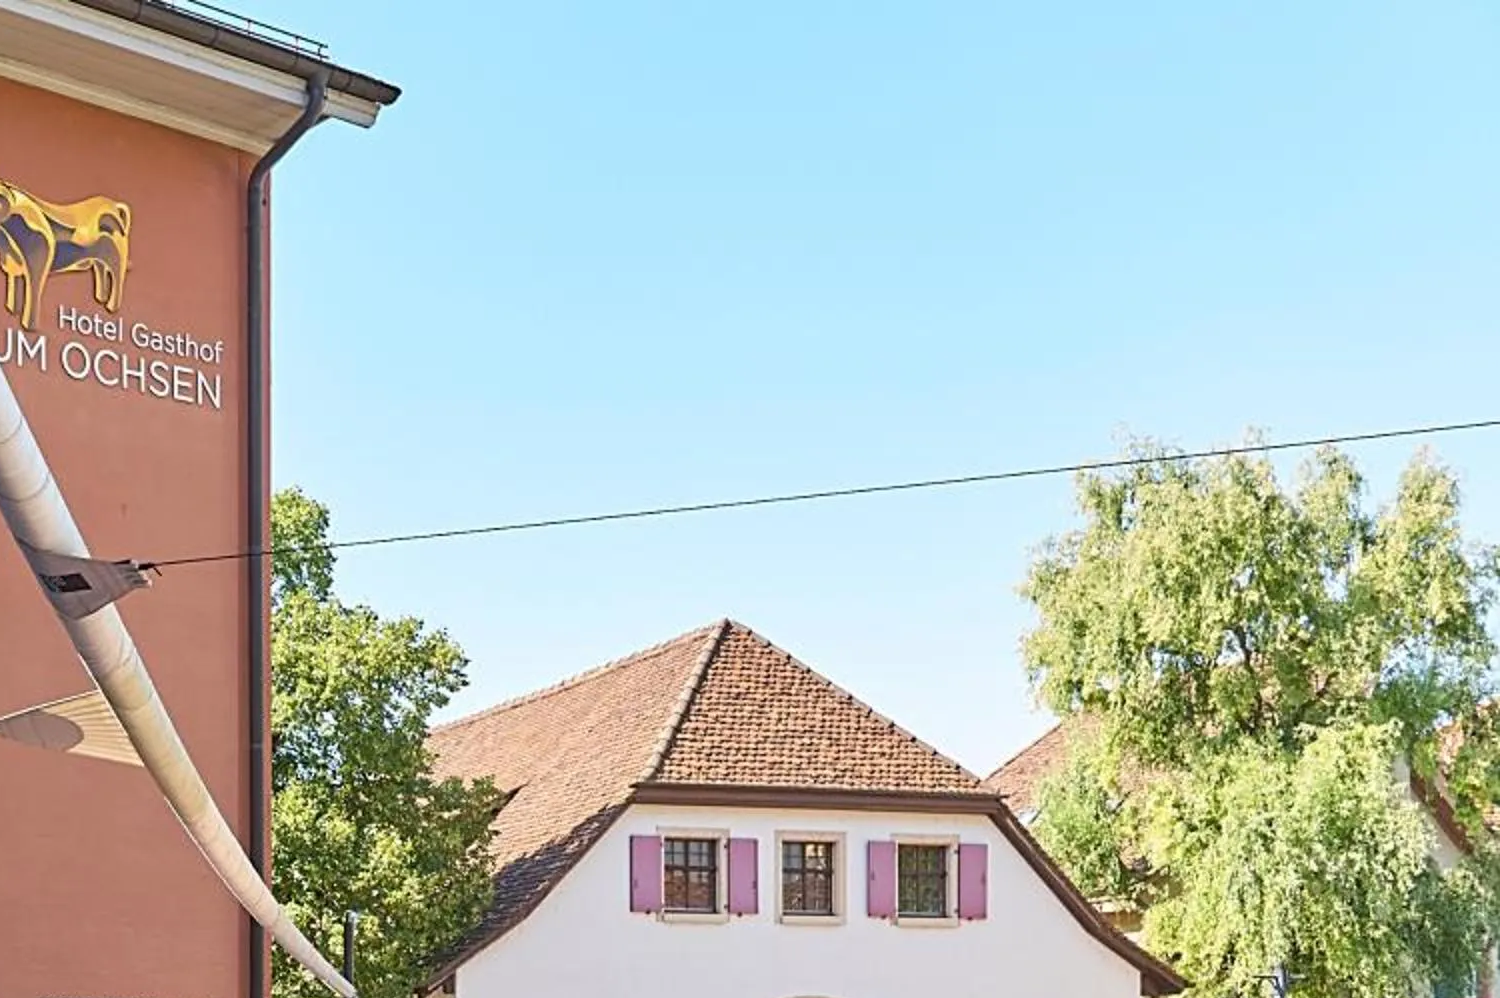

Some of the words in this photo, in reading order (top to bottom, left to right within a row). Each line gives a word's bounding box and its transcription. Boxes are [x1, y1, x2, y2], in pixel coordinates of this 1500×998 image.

[59, 305, 123, 342] Hotel
[132, 323, 224, 364] Gasthof
[61, 341, 221, 408] OCHSEN
